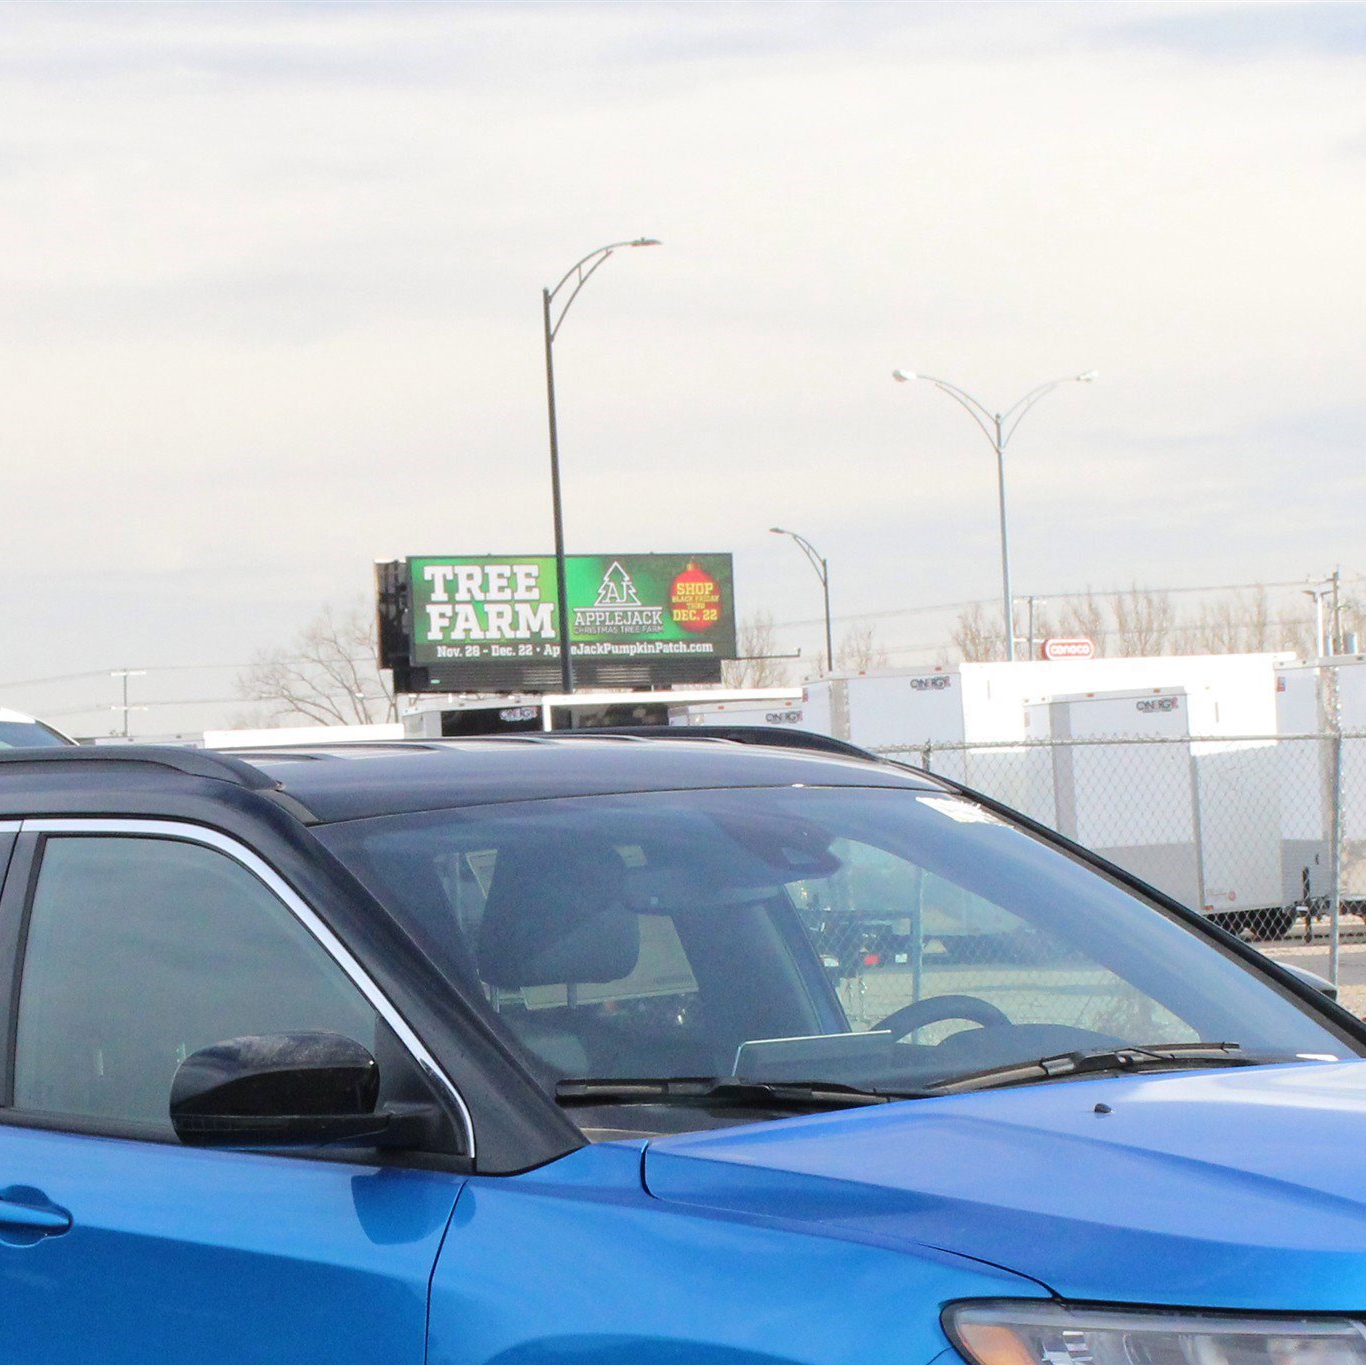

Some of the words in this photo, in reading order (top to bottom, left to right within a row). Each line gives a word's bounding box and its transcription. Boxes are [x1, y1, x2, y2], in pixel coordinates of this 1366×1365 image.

[423, 565, 540, 602] TREE
[676, 582, 714, 596] SHOP
[426, 602, 557, 641] FARM
[575, 610, 663, 626] APPLEJACK
[672, 609, 702, 622] DEC.
[703, 609, 718, 621] 22
[574, 625, 619, 635] CHRISTMAS
[620, 625, 641, 634] TREE
[642, 624, 664, 634] FARM
[437, 645, 463, 658] Nov.
[464, 645, 481, 657] 28
[491, 644, 517, 657] Dec.
[518, 644, 533, 656] 22
[543, 641, 714, 658] ApeJackPumpkinPatch.com
